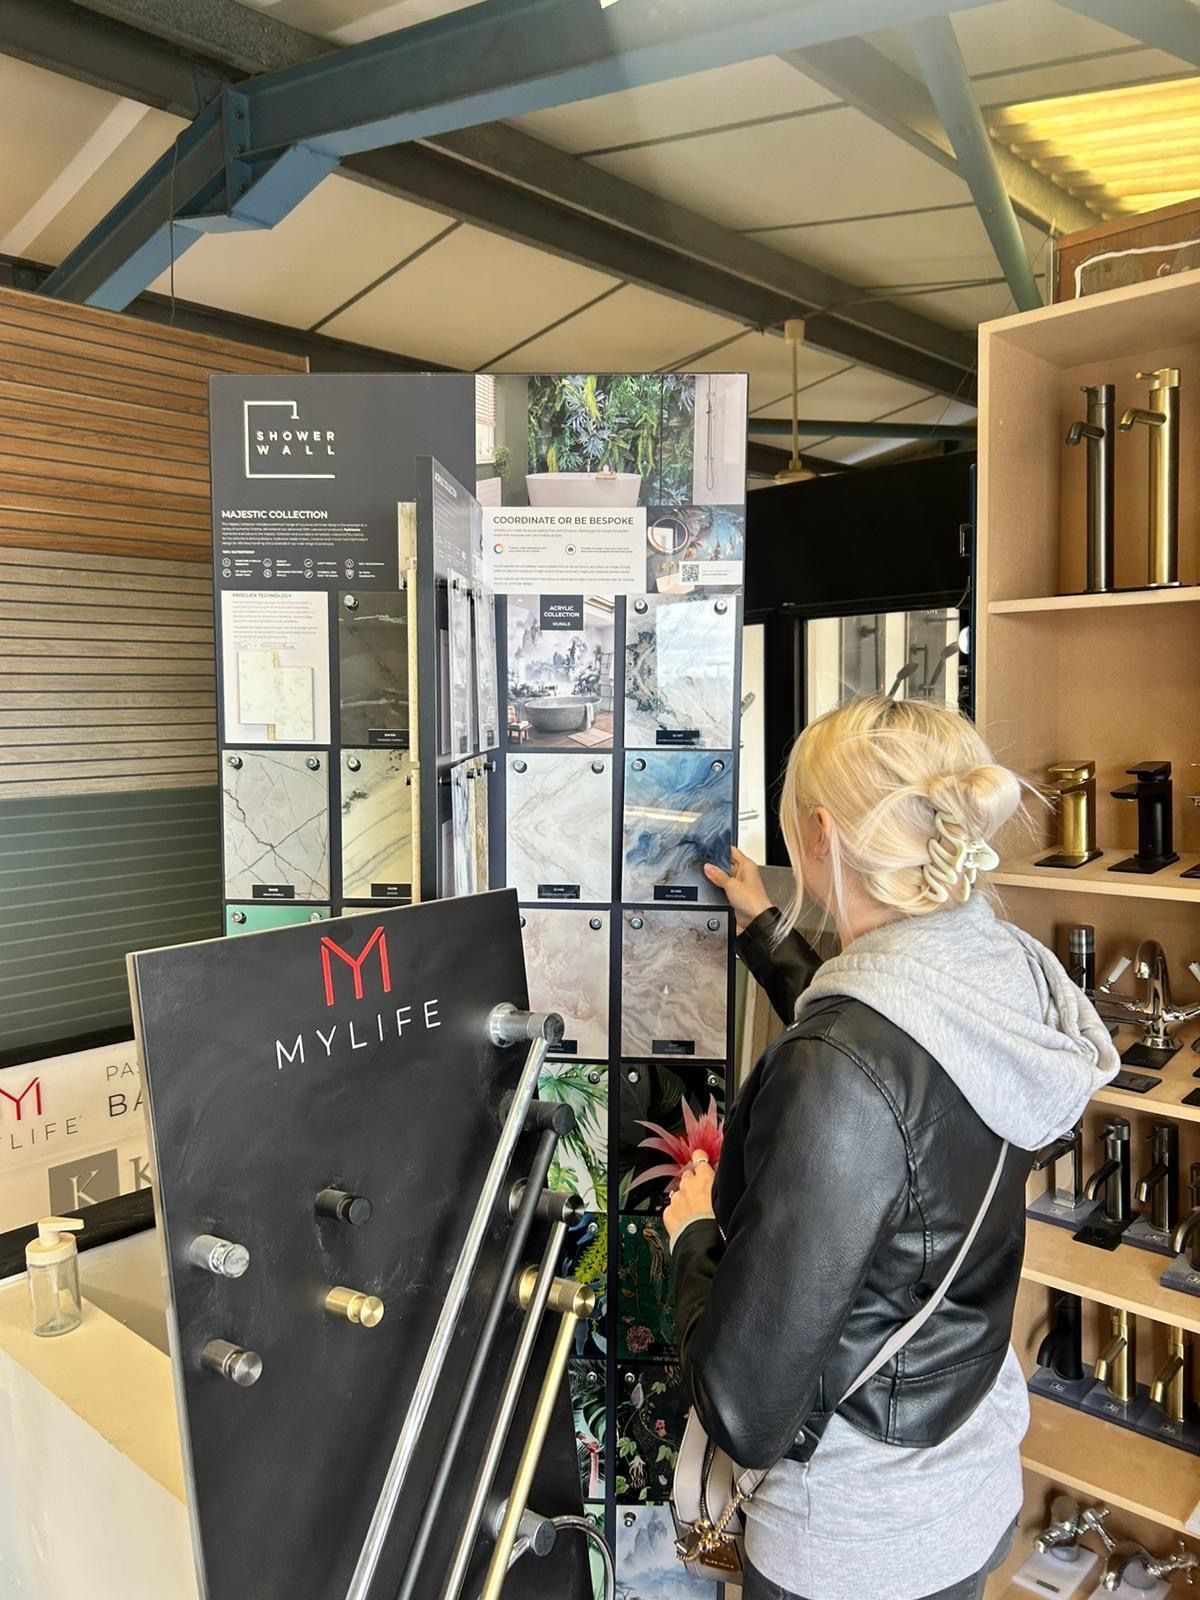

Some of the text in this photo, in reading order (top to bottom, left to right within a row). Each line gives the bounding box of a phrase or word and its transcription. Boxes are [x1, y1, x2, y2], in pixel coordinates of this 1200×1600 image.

[256, 431, 335, 441] SHOWER
[256, 445, 335, 455] WALL
[221, 510, 328, 519] MAJESTIC COLLECTION
[493, 516, 634, 525] COORDINATE OR BE BESPOKE
[275, 999, 441, 1070] MYLIFE
[0, 1116, 79, 1150] LIFE
